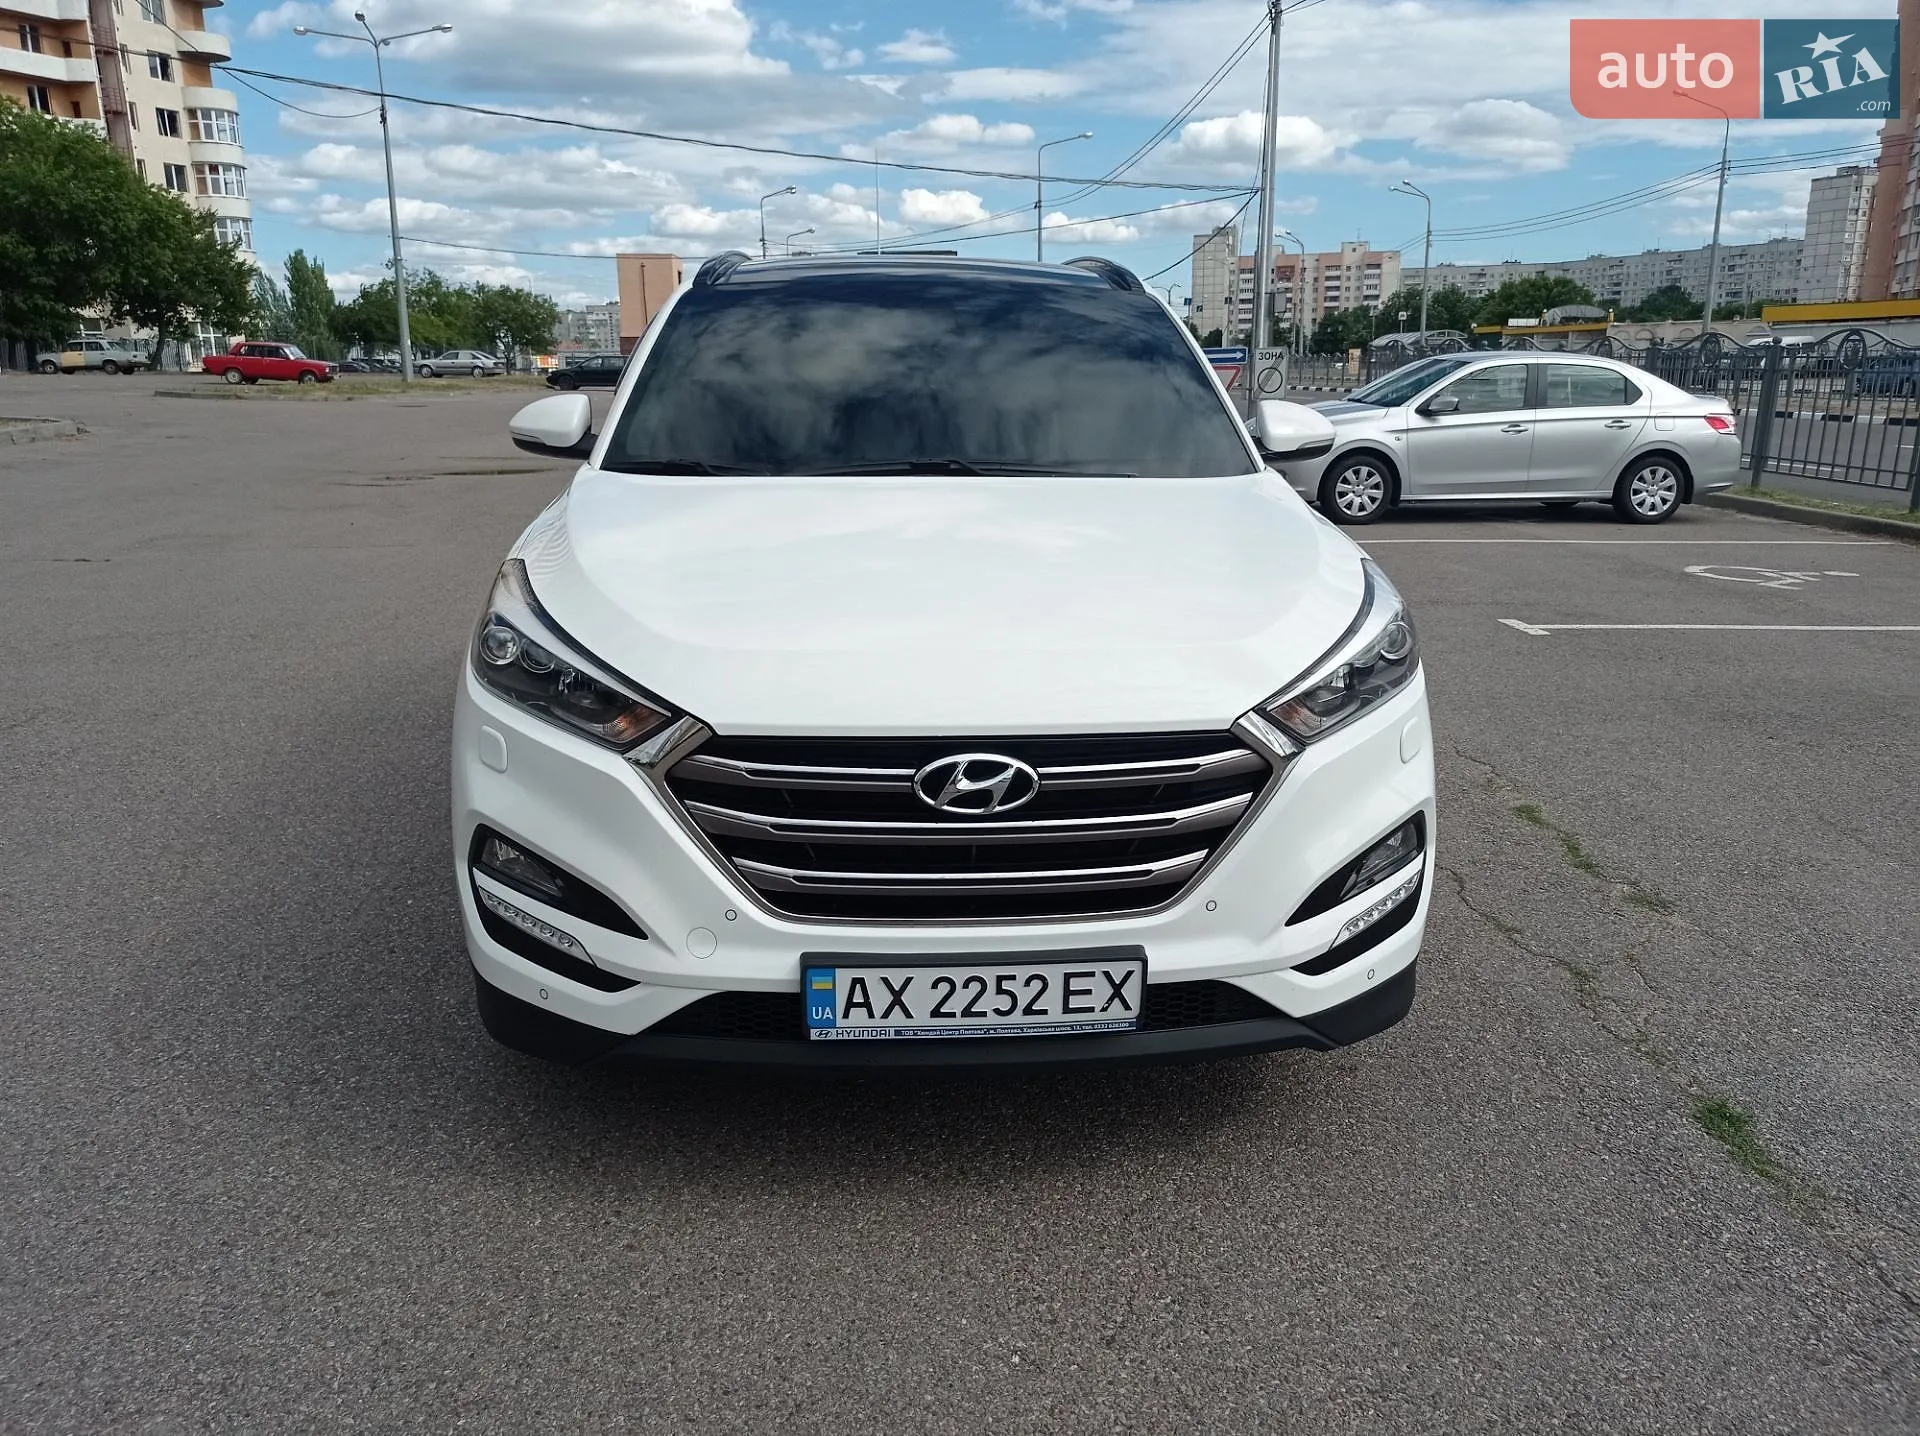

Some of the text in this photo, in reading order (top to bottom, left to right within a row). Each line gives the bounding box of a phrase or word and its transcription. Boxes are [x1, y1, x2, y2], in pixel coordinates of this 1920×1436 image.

[1258, 351, 1284, 360] ЗОНА
[841, 969, 1137, 1020] AX 2252 EX
[812, 1006, 833, 1020] UA
[835, 1029, 891, 1038] HYUNDAI
